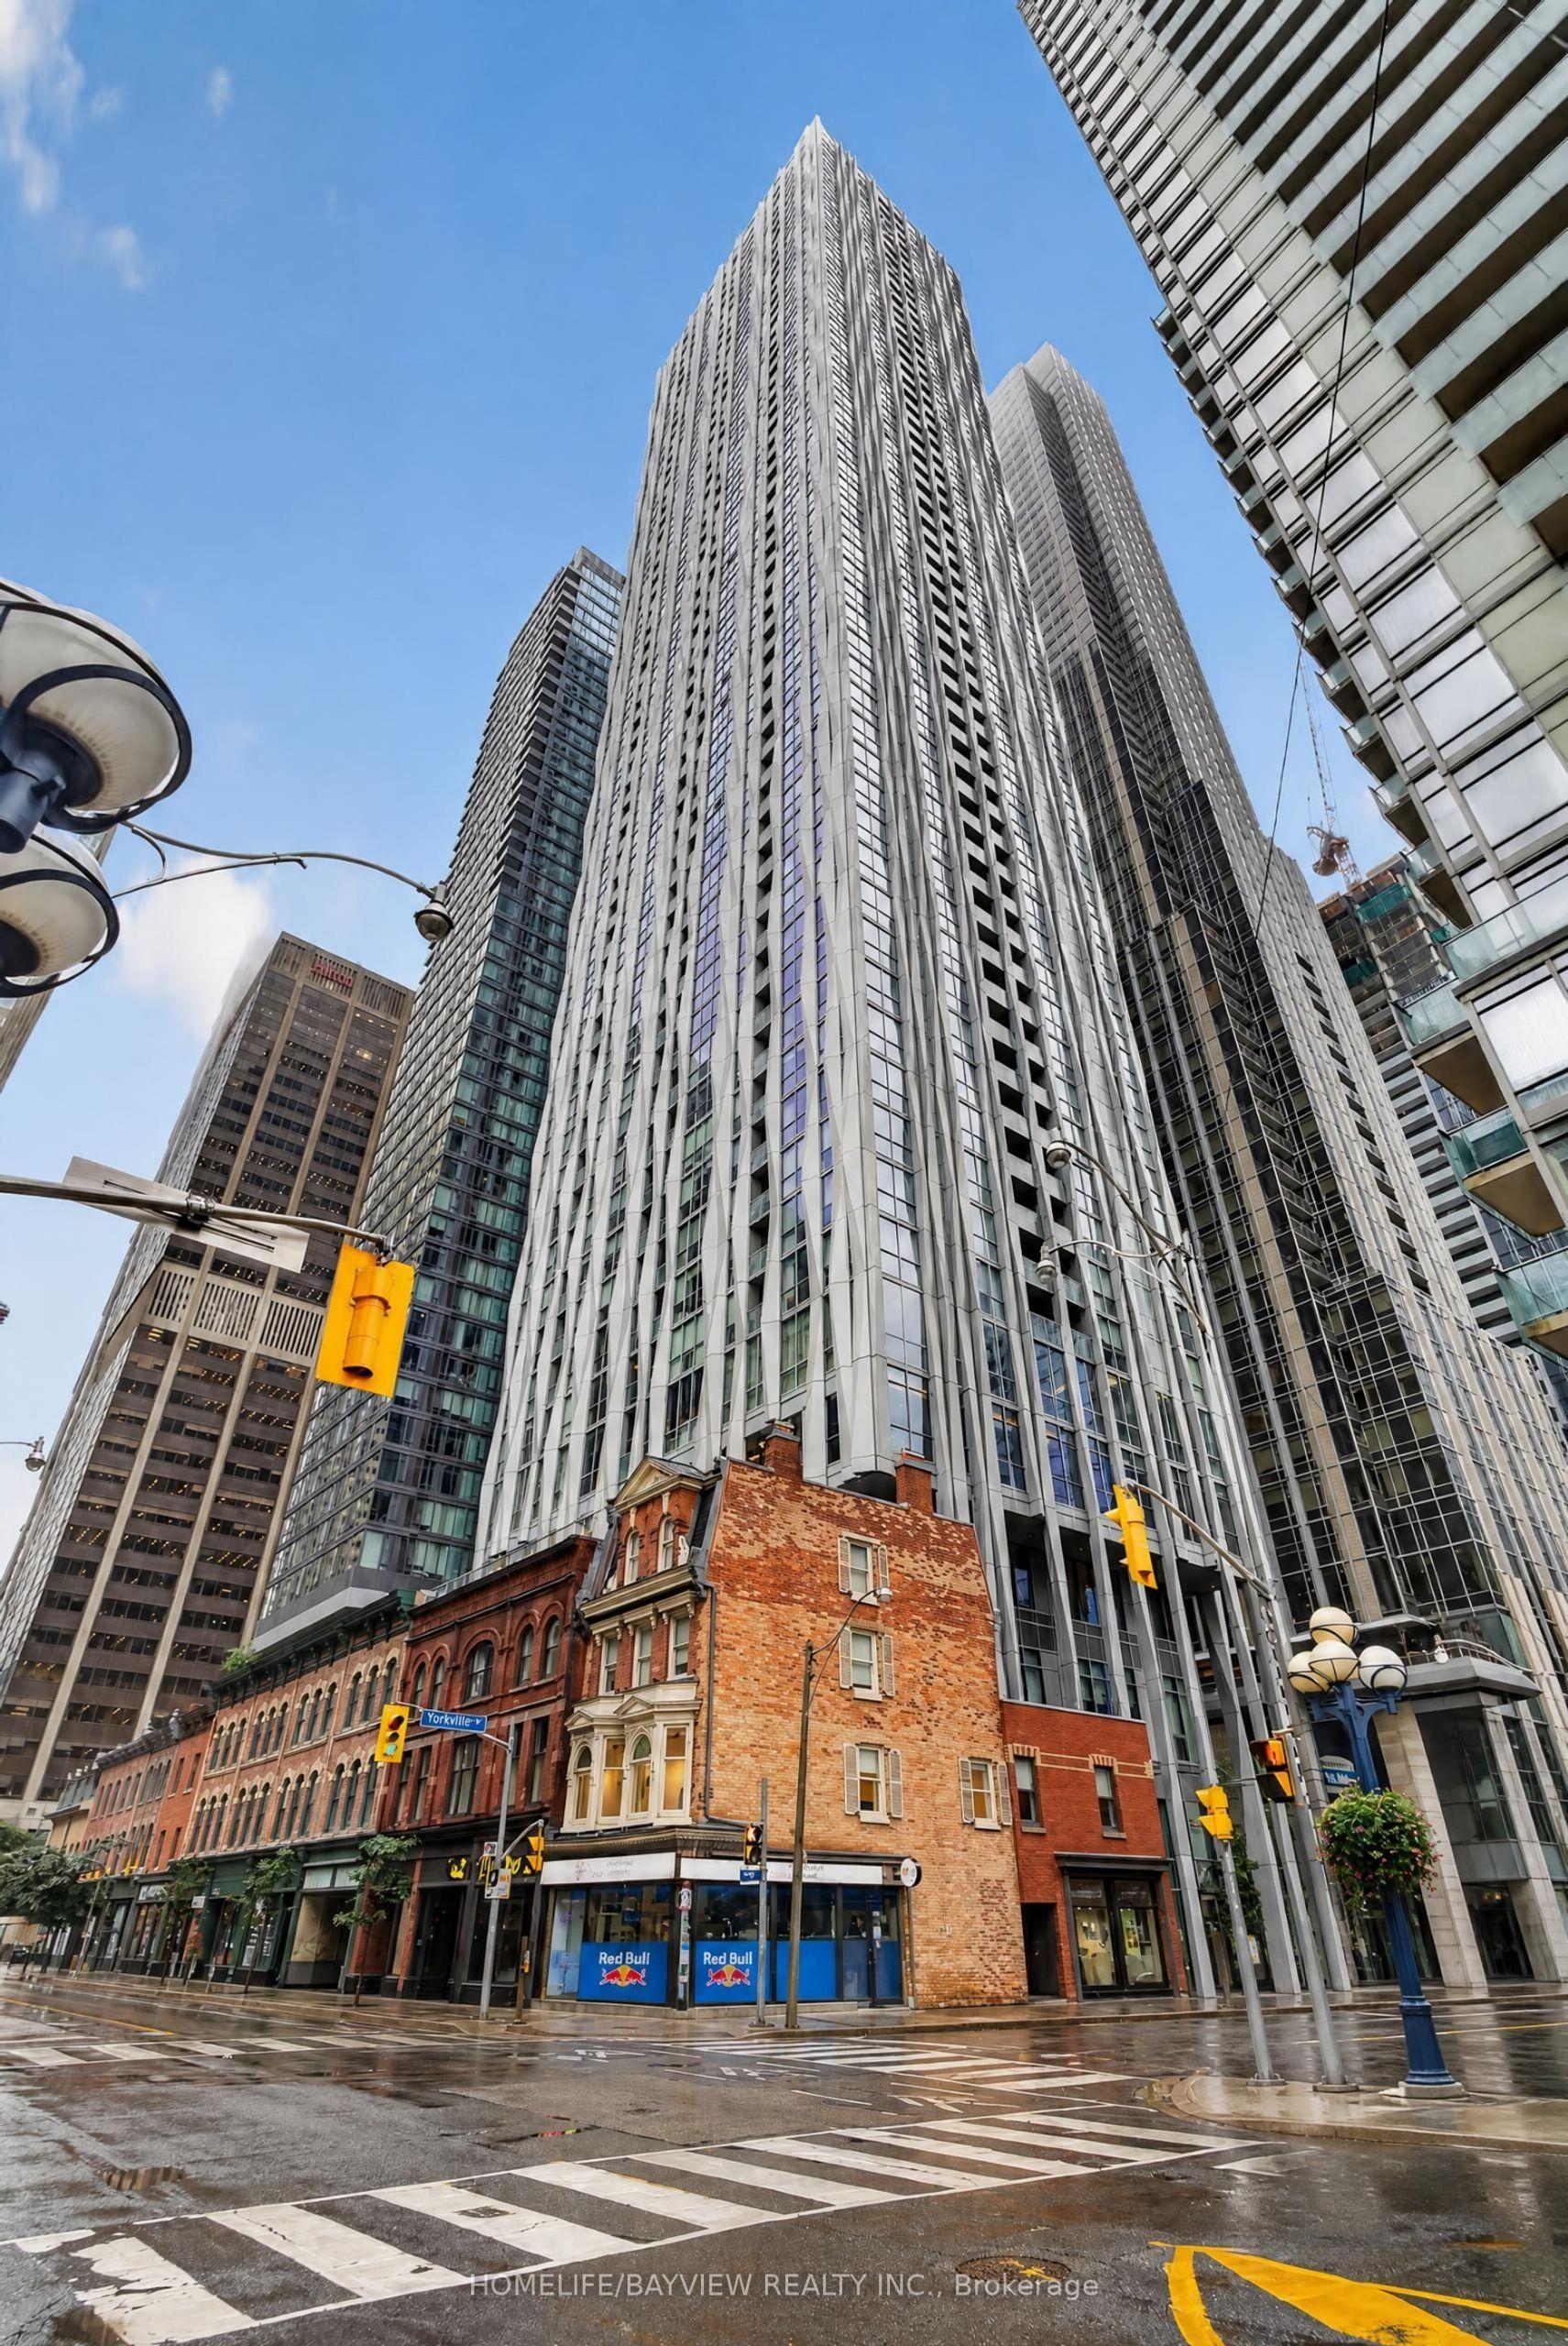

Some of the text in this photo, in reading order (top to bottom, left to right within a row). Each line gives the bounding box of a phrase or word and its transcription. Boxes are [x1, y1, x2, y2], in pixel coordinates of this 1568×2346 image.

[427, 1712, 470, 1727] Yorkville
[598, 1951, 650, 1965] Red Bull
[703, 1951, 752, 1965] Red Bull
